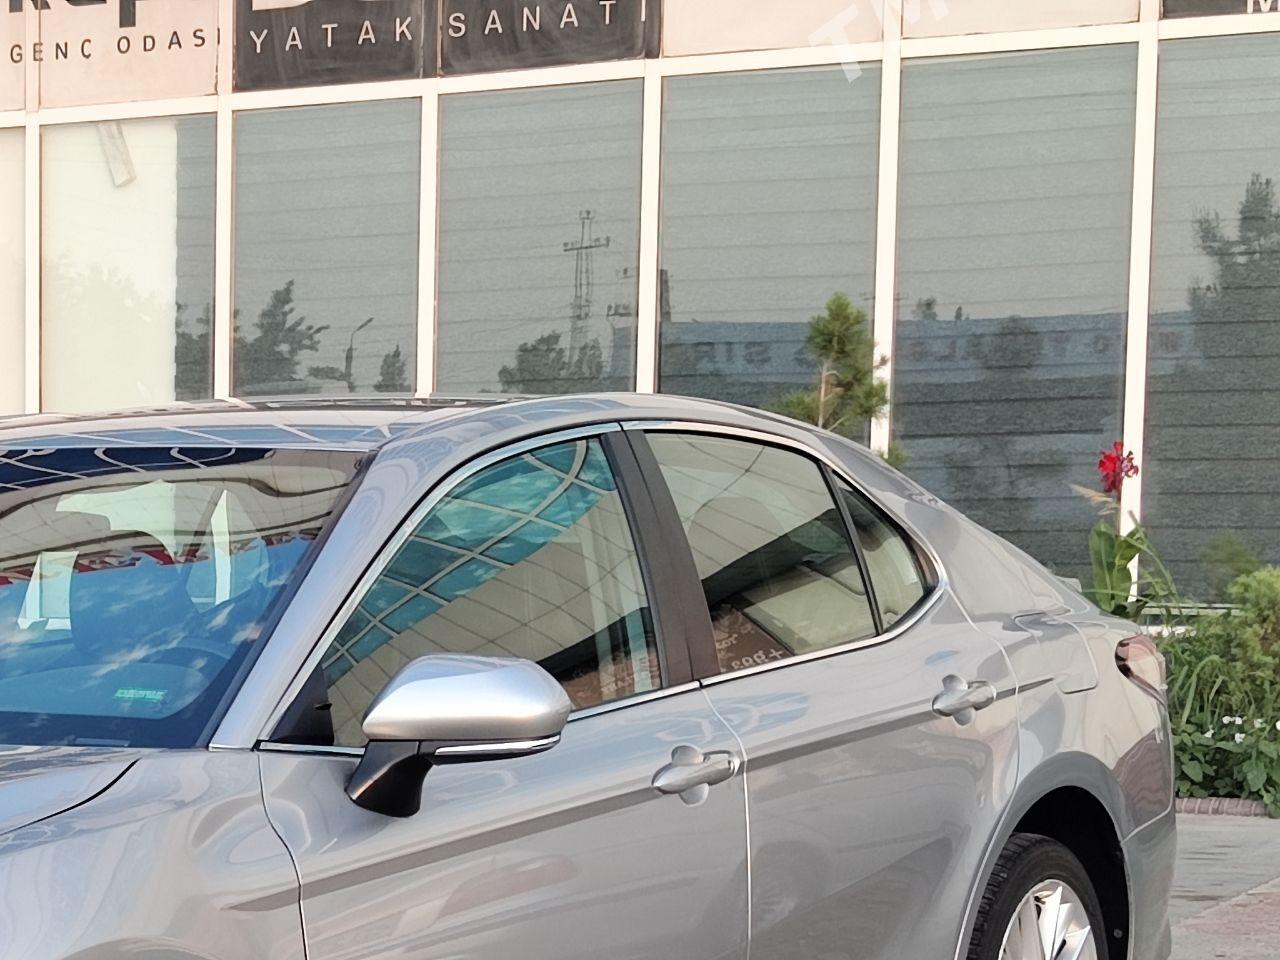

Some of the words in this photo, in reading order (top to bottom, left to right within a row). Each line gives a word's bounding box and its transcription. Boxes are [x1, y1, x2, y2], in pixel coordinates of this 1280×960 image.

[116, 27, 221, 54] ODASI
[249, 16, 414, 54] YATAK
[448, 0, 647, 38] SANATI
